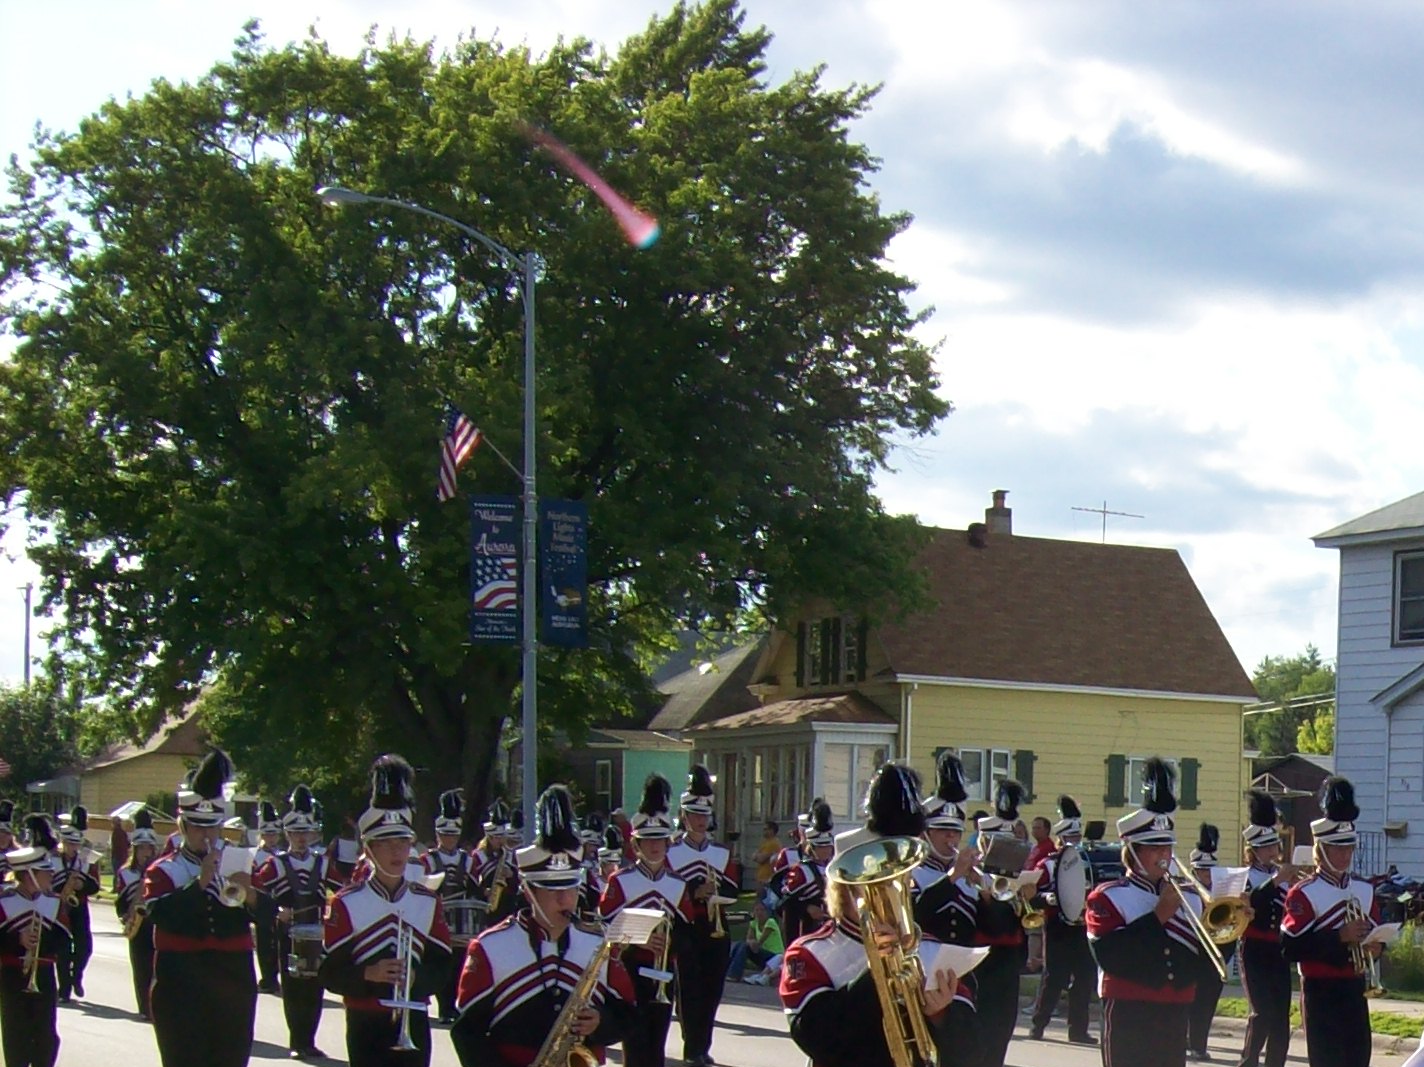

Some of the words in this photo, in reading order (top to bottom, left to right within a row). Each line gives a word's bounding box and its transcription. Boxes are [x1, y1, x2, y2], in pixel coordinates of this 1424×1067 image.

[474, 509, 513, 523] Welcome
[547, 510, 581, 523] Northern
[492, 524, 501, 534] to
[553, 521, 575, 534] Lights
[474, 533, 516, 556] Aurora
